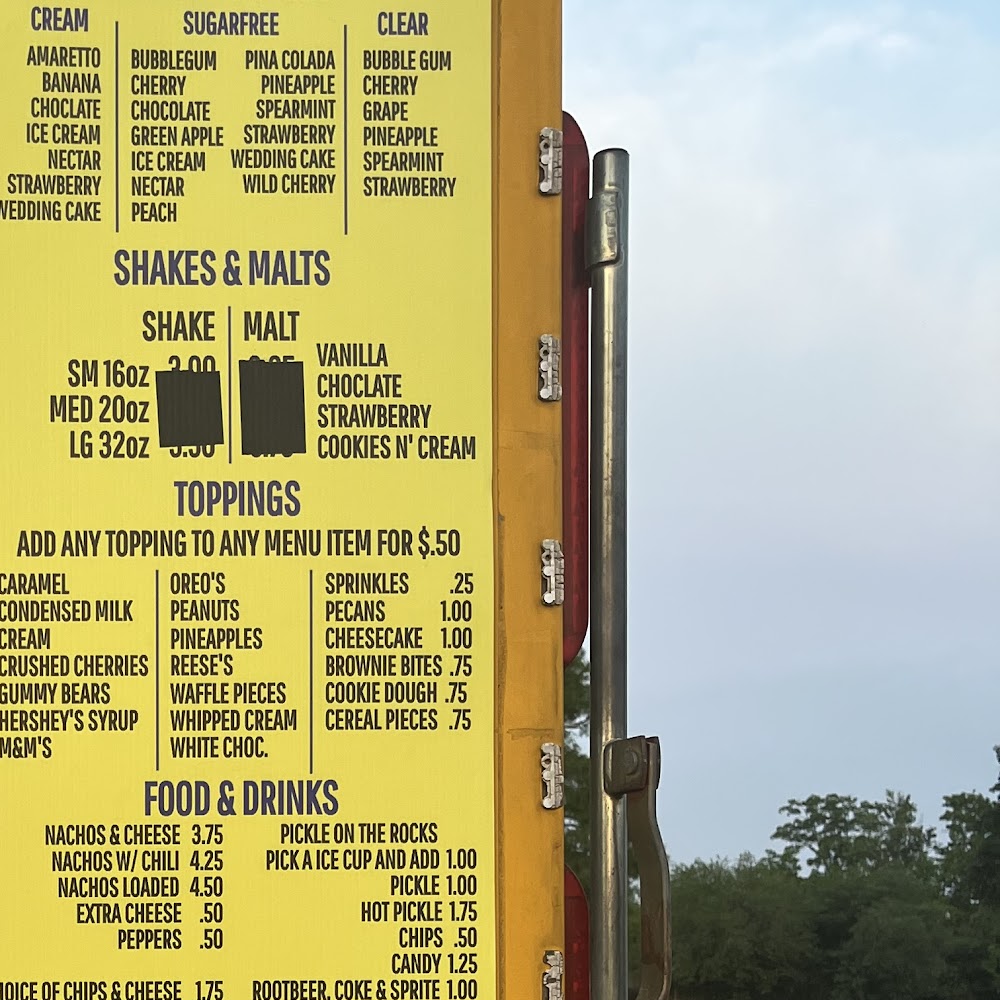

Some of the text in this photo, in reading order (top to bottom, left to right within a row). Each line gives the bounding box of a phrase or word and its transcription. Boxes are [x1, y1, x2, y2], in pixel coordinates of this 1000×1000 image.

[30, 7, 89, 32] CREAM
[182, 11, 280, 35] SUGARFREE
[377, 12, 429, 35] CLEAR
[26, 46, 101, 68] AMARETTO
[245, 50, 336, 70] PINA COLADA
[30, 97, 102, 119] CHOCLATE
[113, 250, 331, 286] SHAKES & MALTS
[67, 359, 99, 387] SM
[102, 360, 150, 387] 16oz
[317, 434, 476, 459] COOKIES N' CREAM
[173, 480, 301, 516] TOPPINGS
[325, 627, 473, 649] CHEESECAKE 1.00
[170, 654, 234, 676] REESE'S
[87, 710, 139, 731] SYRUP
[144, 780, 339, 816] FOOD & DRINKS
[280, 823, 438, 844] PICKLE ON THE ROCKS
[51, 850, 224, 872] NACHOS W/ CHILI 4.25
